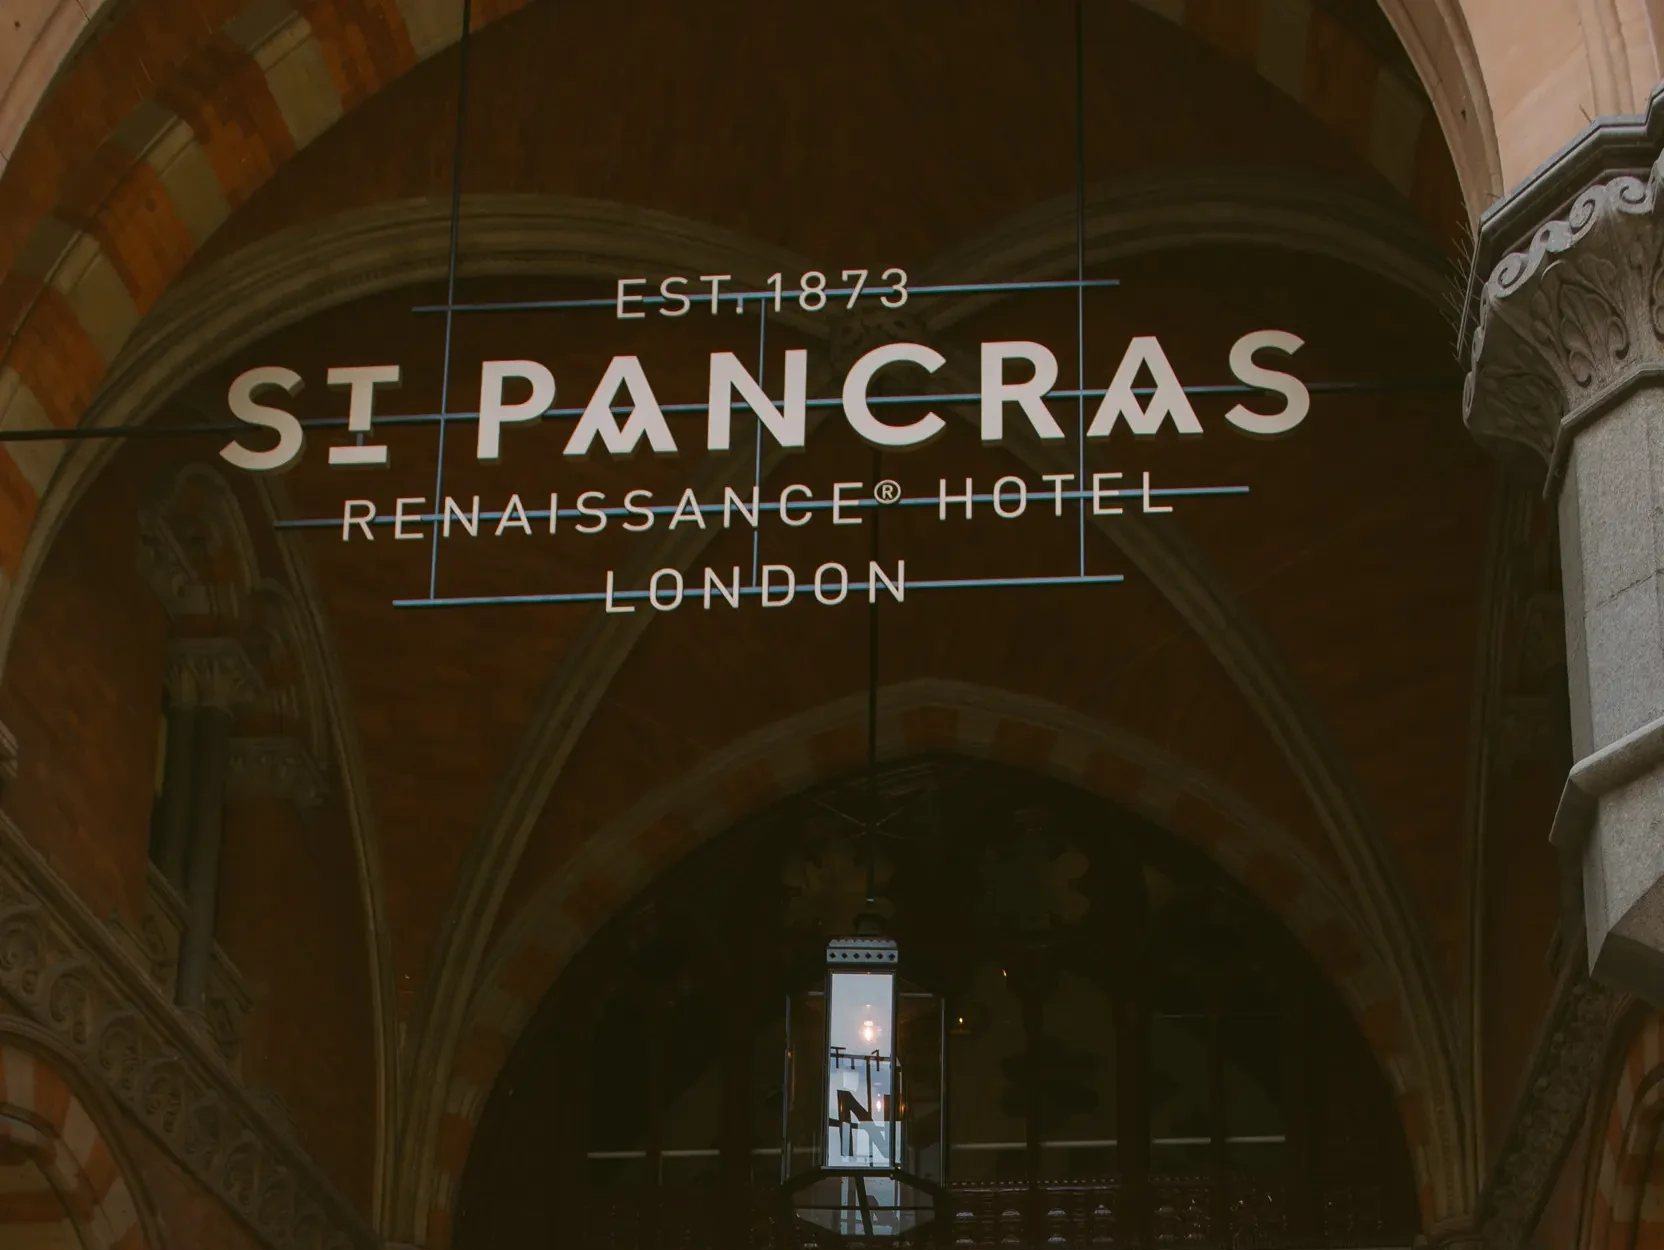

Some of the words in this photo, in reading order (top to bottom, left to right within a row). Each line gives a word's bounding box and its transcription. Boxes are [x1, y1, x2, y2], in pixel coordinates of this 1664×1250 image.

[616, 274, 746, 318] EST.
[767, 267, 908, 312] 1873
[219, 364, 401, 470] ST
[476, 329, 1311, 460] PANCRAS
[938, 471, 1175, 520] HOTEL
[605, 559, 906, 613] LONDON
